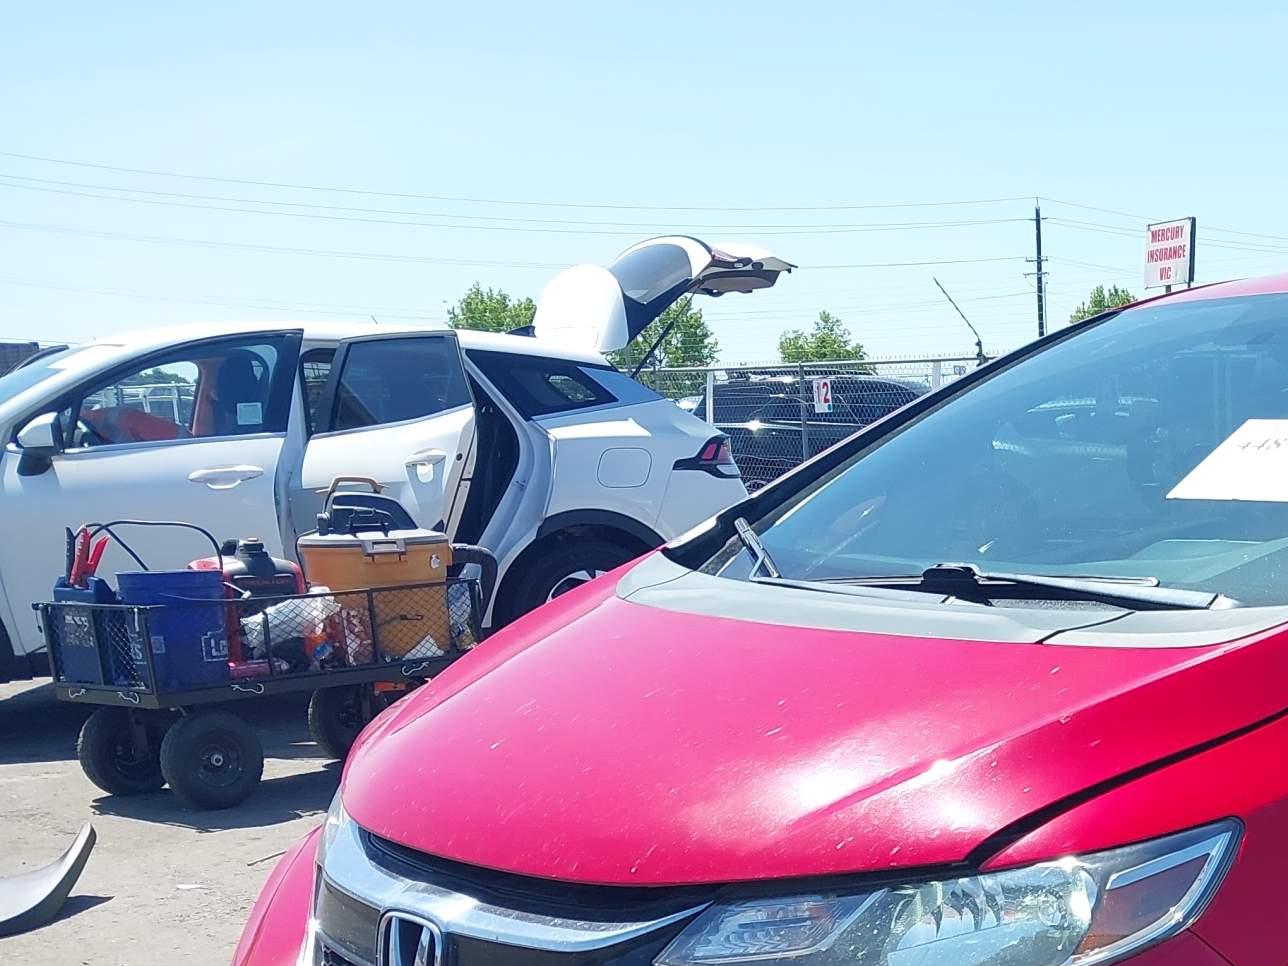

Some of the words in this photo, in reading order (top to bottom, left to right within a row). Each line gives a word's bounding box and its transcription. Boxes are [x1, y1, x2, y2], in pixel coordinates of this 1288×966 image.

[1151, 225, 1185, 243] MERCURY
[1147, 244, 1187, 264] INSURANCE
[1160, 266, 1172, 281] VIC
